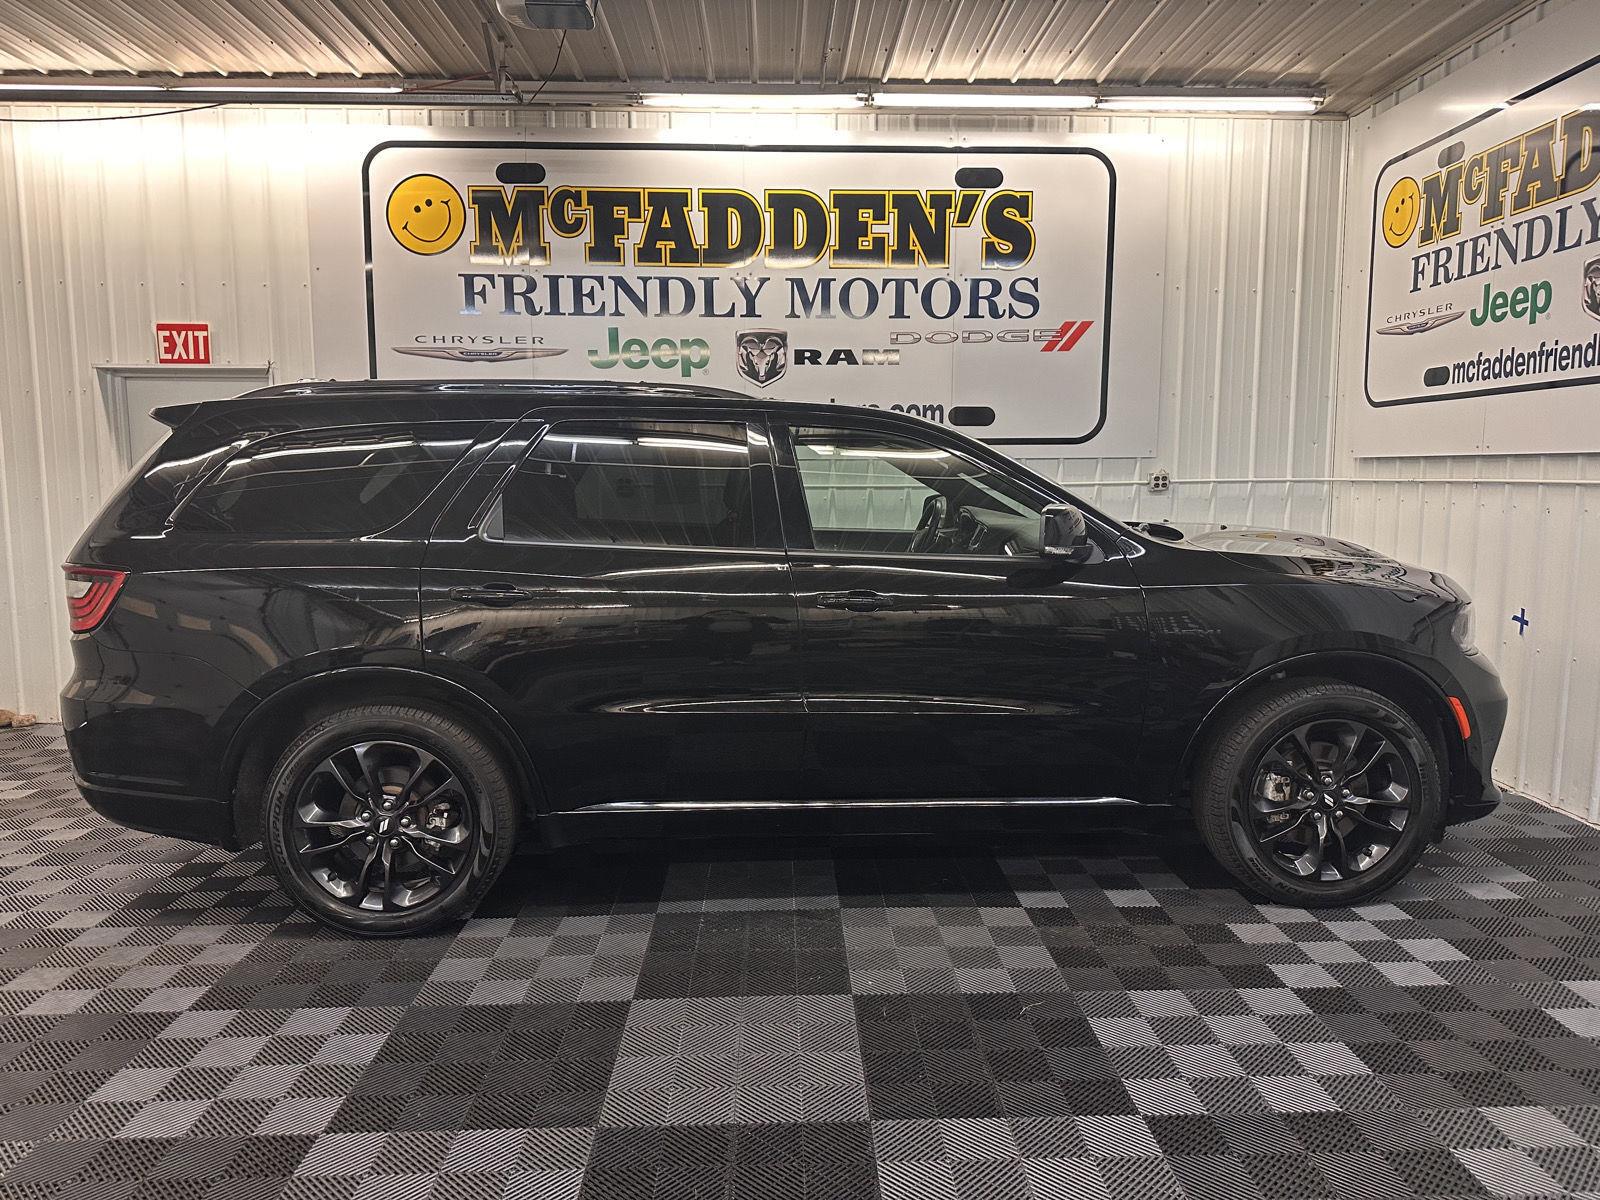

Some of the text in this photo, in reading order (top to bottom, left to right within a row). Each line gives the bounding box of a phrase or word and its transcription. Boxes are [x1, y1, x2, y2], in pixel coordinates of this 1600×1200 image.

[1409, 197, 1600, 294] FRIENDLY
[458, 273, 1041, 319] FRIENDLY MOTORS
[1470, 279, 1553, 327] Jeep
[1386, 302, 1453, 324] CHRYSLER
[157, 330, 208, 360] EXIT
[415, 335, 545, 345] CHRYSLER
[890, 328, 1065, 345] DODGE
[588, 327, 711, 378] Jeep
[793, 348, 900, 366] RAM
